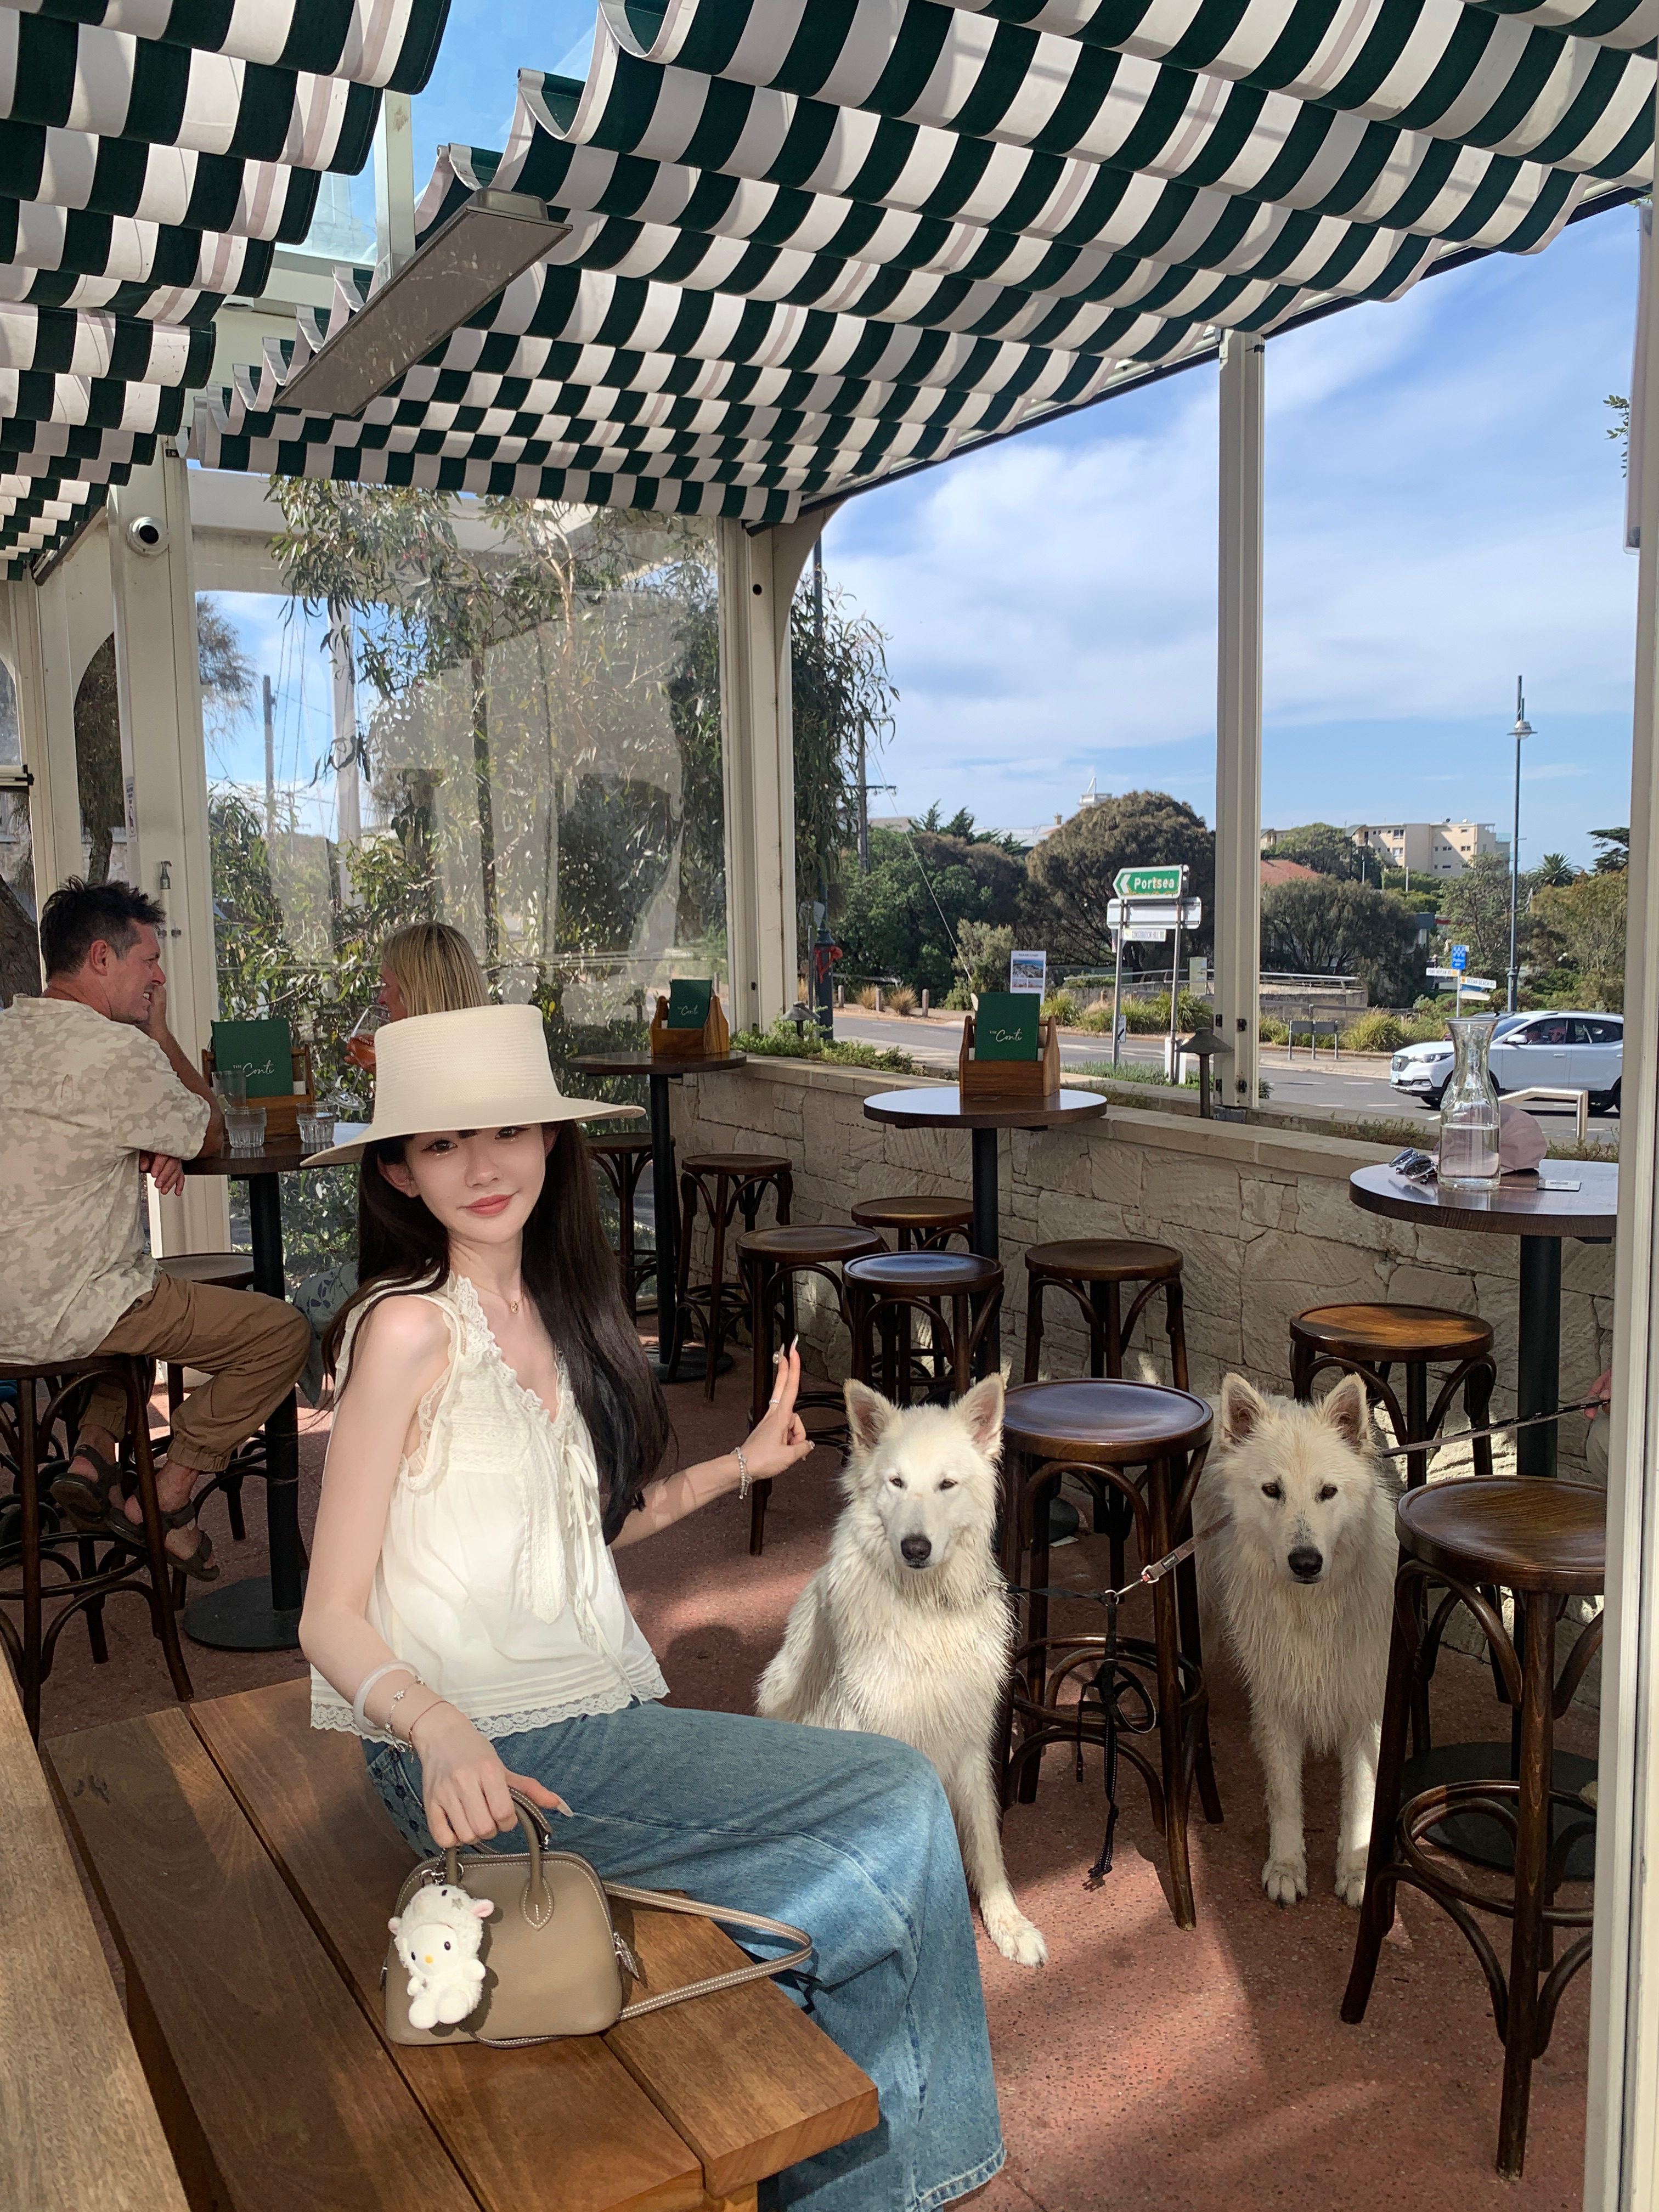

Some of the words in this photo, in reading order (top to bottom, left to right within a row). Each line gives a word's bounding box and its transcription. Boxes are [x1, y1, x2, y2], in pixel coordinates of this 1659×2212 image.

[1134, 877, 1175, 890] Portsea
[1132, 930, 1152, 939] CONSTITUTION
[1160, 931, 1164, 939] RD
[359, 1036, 374, 1046] CONT
[996, 1028, 1022, 1042] Conti
[242, 1060, 274, 1077] Conti
